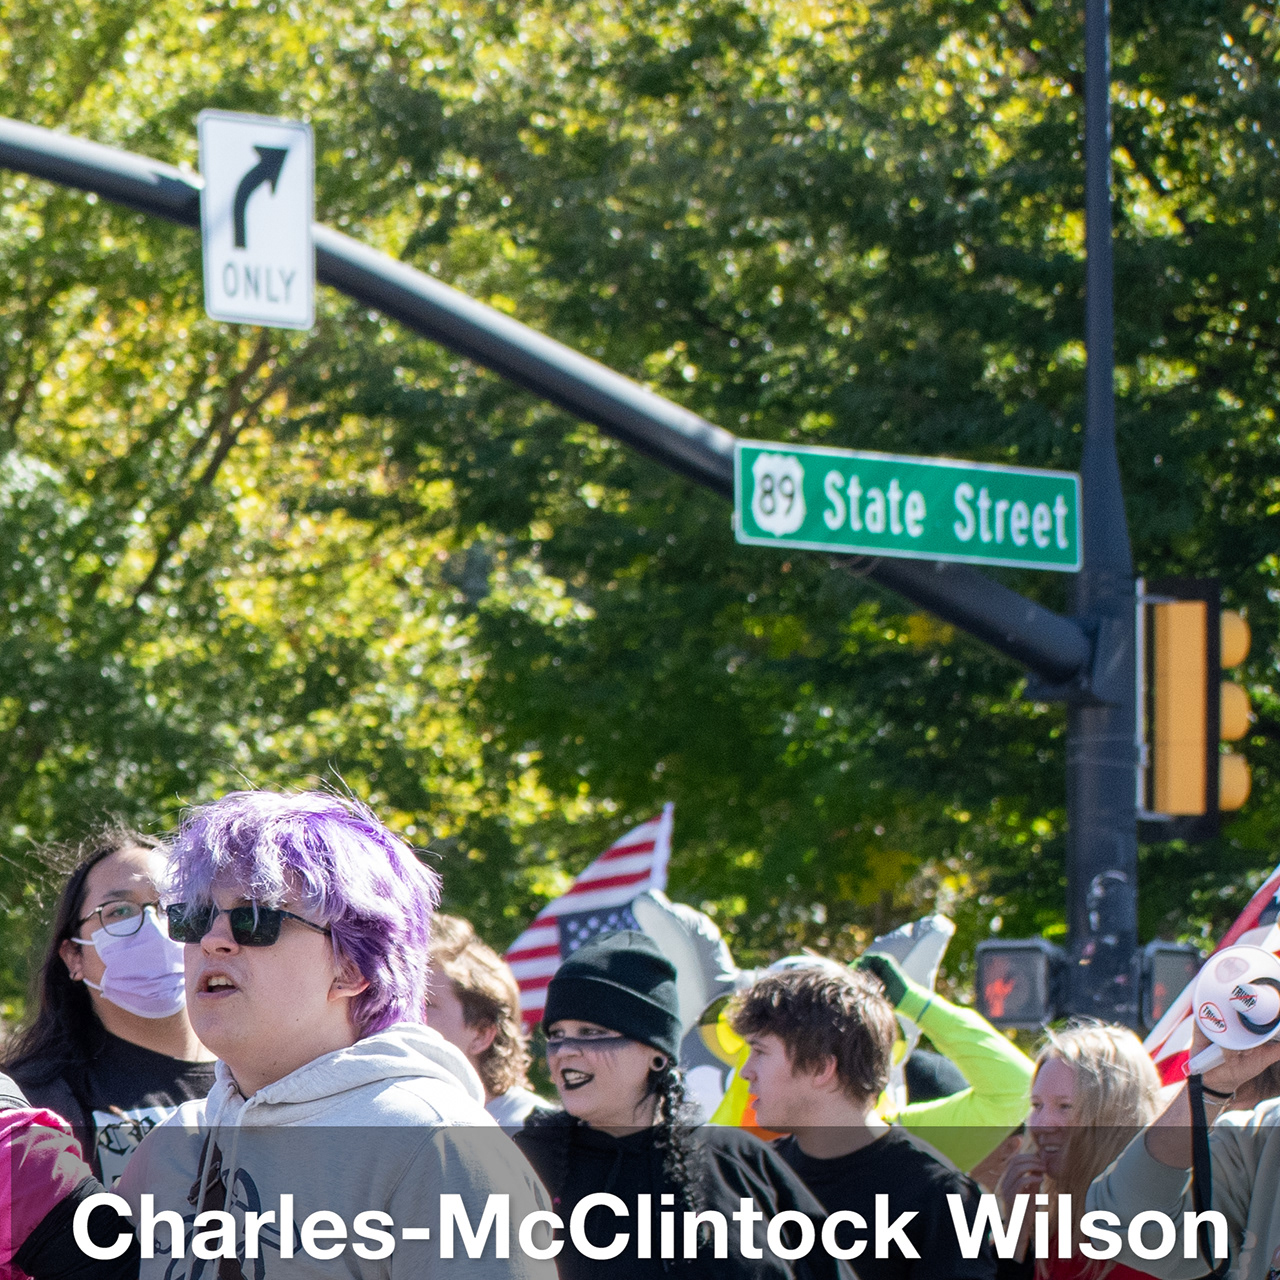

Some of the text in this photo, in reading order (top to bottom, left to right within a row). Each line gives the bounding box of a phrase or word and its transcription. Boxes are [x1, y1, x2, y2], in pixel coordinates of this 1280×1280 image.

[223, 262, 296, 304] ONLY
[760, 470, 1069, 549] 89 State Street
